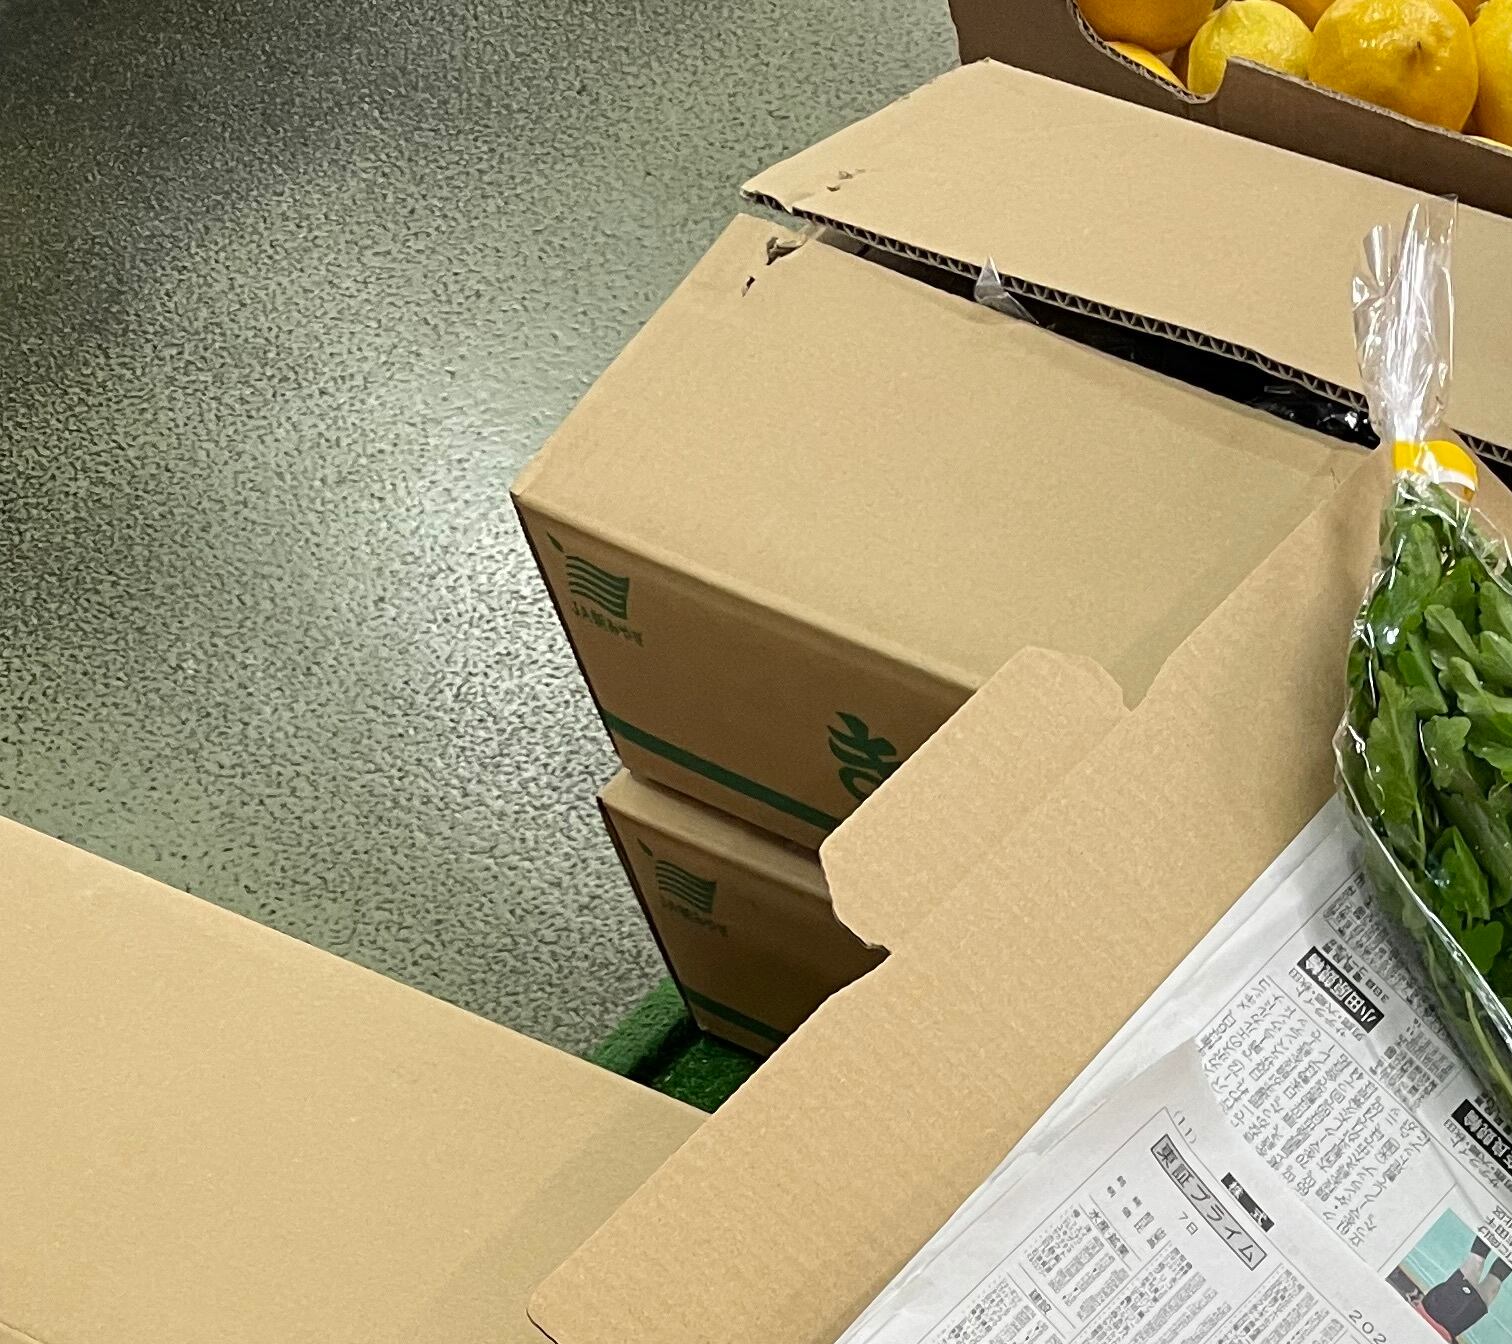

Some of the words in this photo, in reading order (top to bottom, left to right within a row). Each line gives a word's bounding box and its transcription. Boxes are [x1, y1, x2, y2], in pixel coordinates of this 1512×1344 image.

[1303, 950, 1380, 1026] 小田原競輪
[1153, 1139, 1264, 1264] 東証プライム
